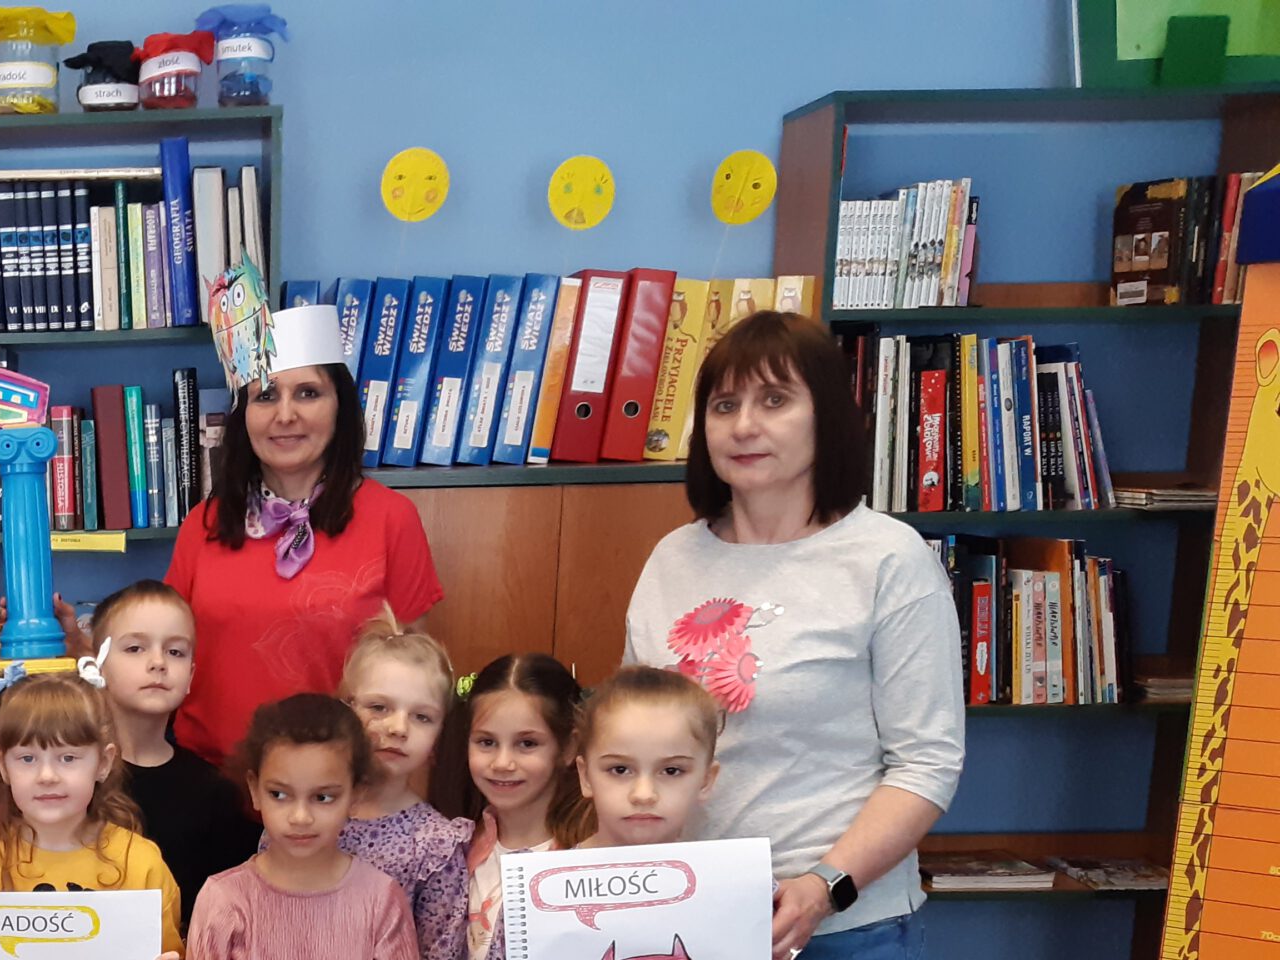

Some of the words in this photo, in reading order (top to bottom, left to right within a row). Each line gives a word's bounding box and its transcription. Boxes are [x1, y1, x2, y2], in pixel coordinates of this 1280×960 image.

[95, 87, 123, 99] strach
[173, 197, 185, 266] GEOGRAFIA
[185, 209, 195, 253] ŚWIATA
[9, 306, 18, 314] VI
[23, 306, 33, 314] VII
[35, 306, 46, 314] VIII
[51, 305, 59, 313] IX
[340, 306, 351, 348] WIAT
[344, 297, 360, 356] WIEDZY
[374, 306, 389, 356] ŚWIAT
[382, 297, 399, 356] WIEDZY
[409, 303, 425, 354] ŚWIAT
[417, 295, 434, 354] WIEDZY
[449, 303, 464, 352] ŚWIAT
[456, 294, 474, 352] WIEDZY
[486, 302, 502, 352] ŚWIAT
[494, 294, 511, 352] WIEDZY
[521, 301, 539, 351] ŚWIAT
[529, 292, 546, 351] WIEDZY
[1023, 415, 1032, 446] RAPORT
[57, 462, 66, 509] HISTORIA
[564, 870, 659, 899] MIŁOŚĆ
